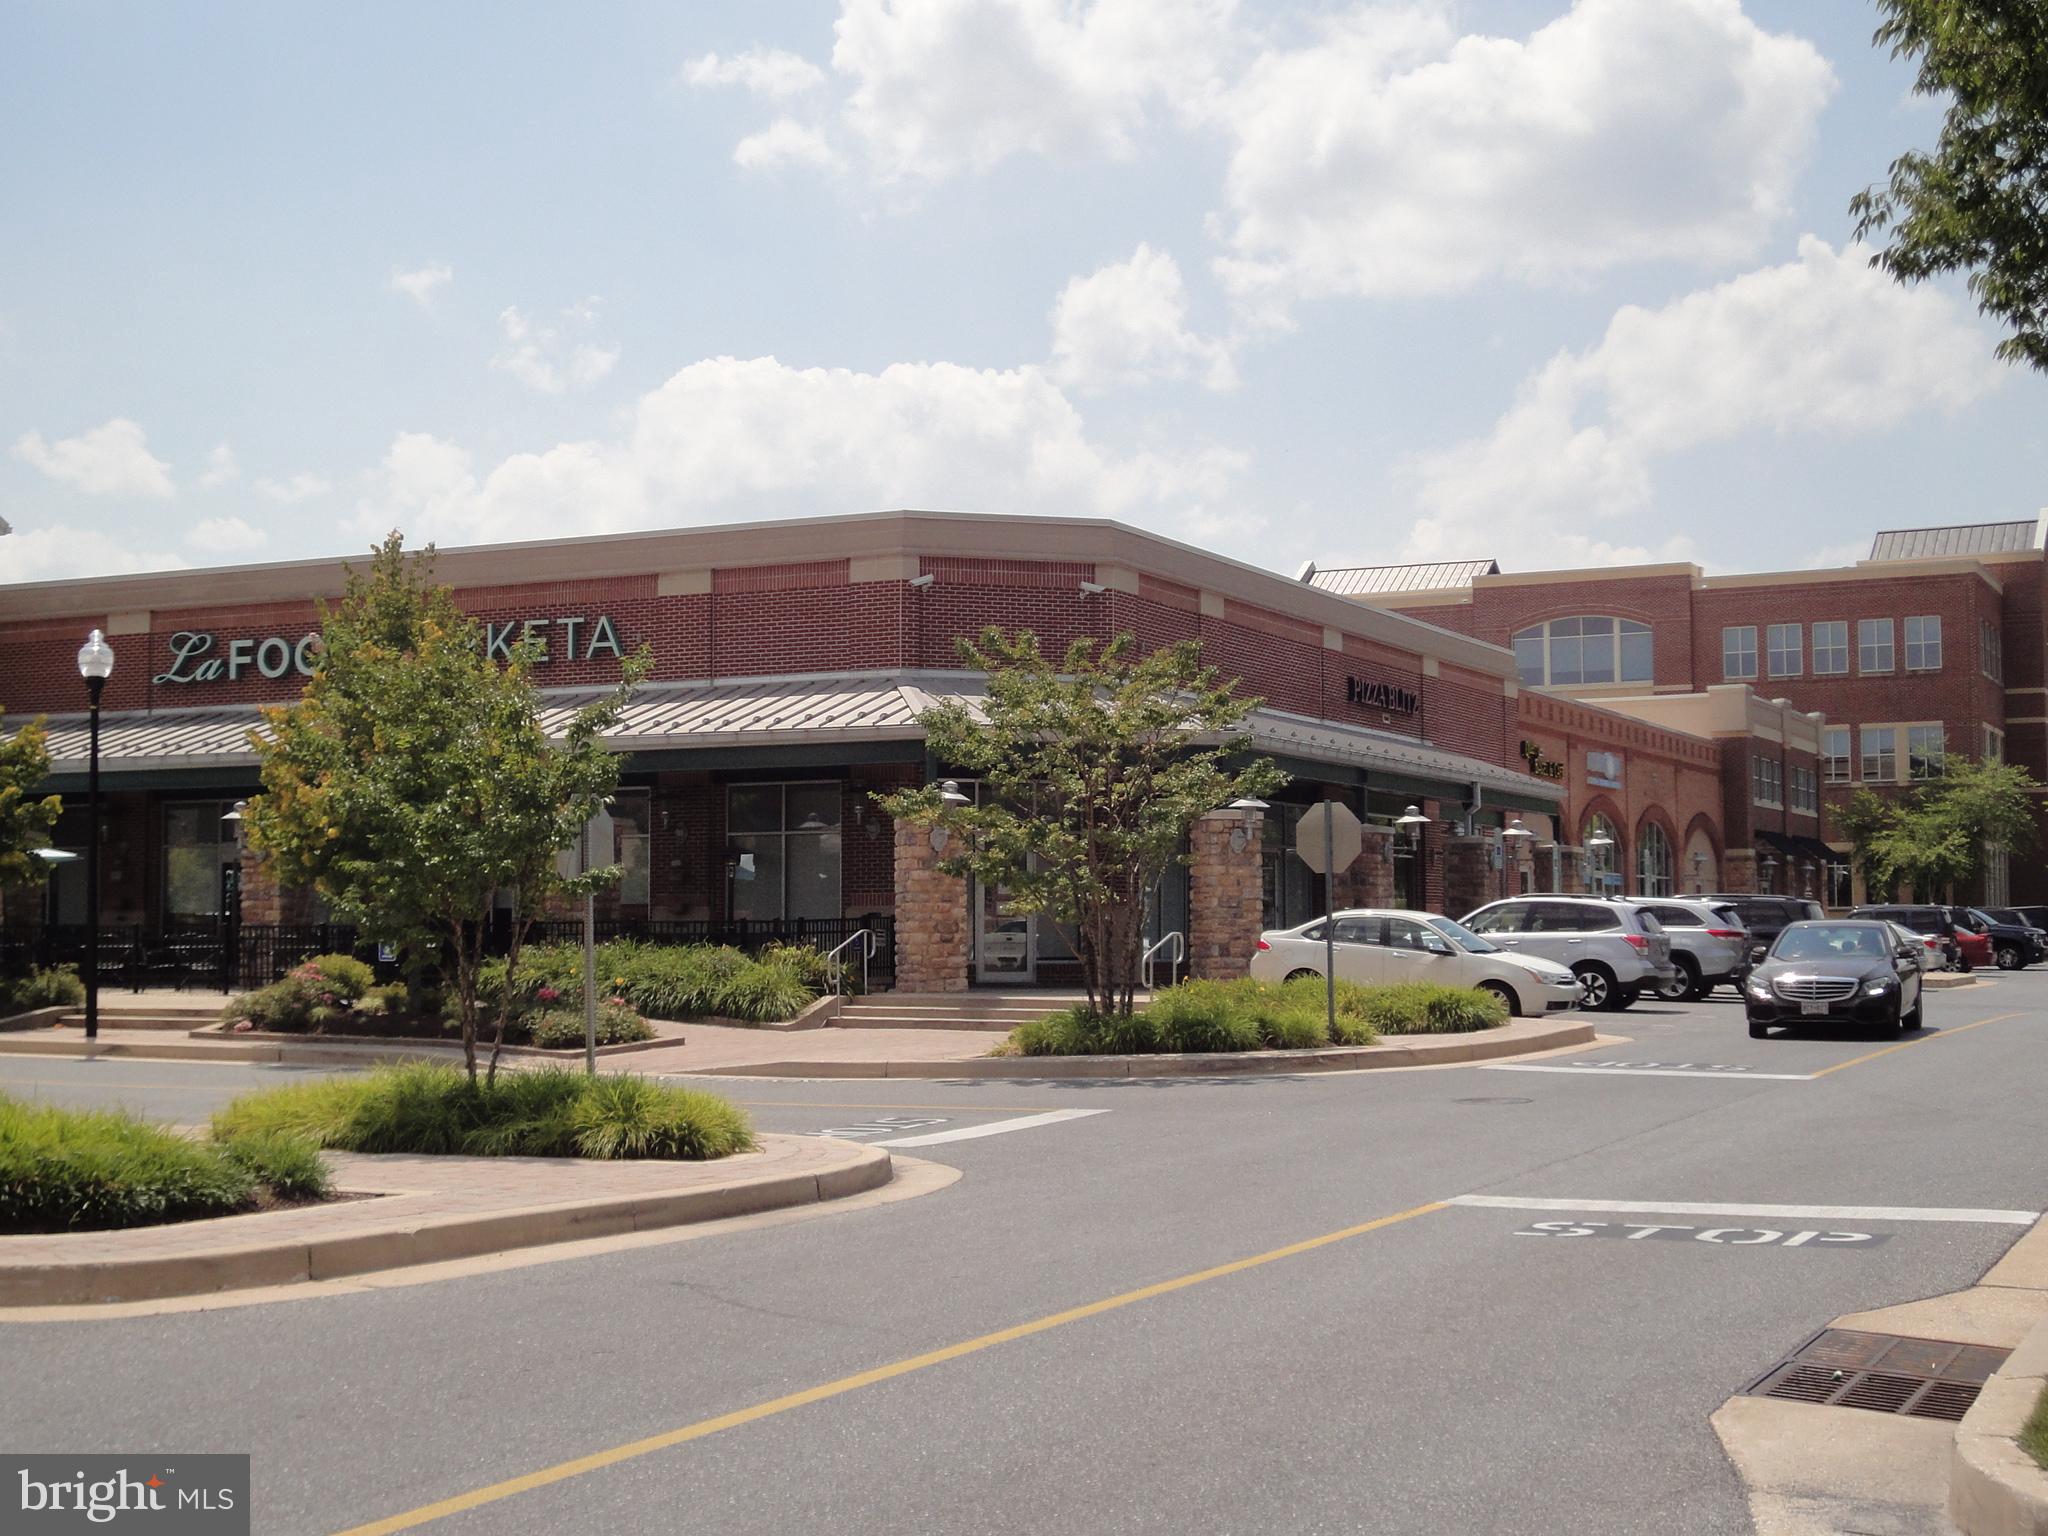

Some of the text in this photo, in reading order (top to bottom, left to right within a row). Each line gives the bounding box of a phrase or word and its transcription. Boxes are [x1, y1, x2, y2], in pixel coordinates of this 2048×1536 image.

[152, 615, 625, 684] La FOO KETA
[1512, 1221, 1875, 1248] STOP
